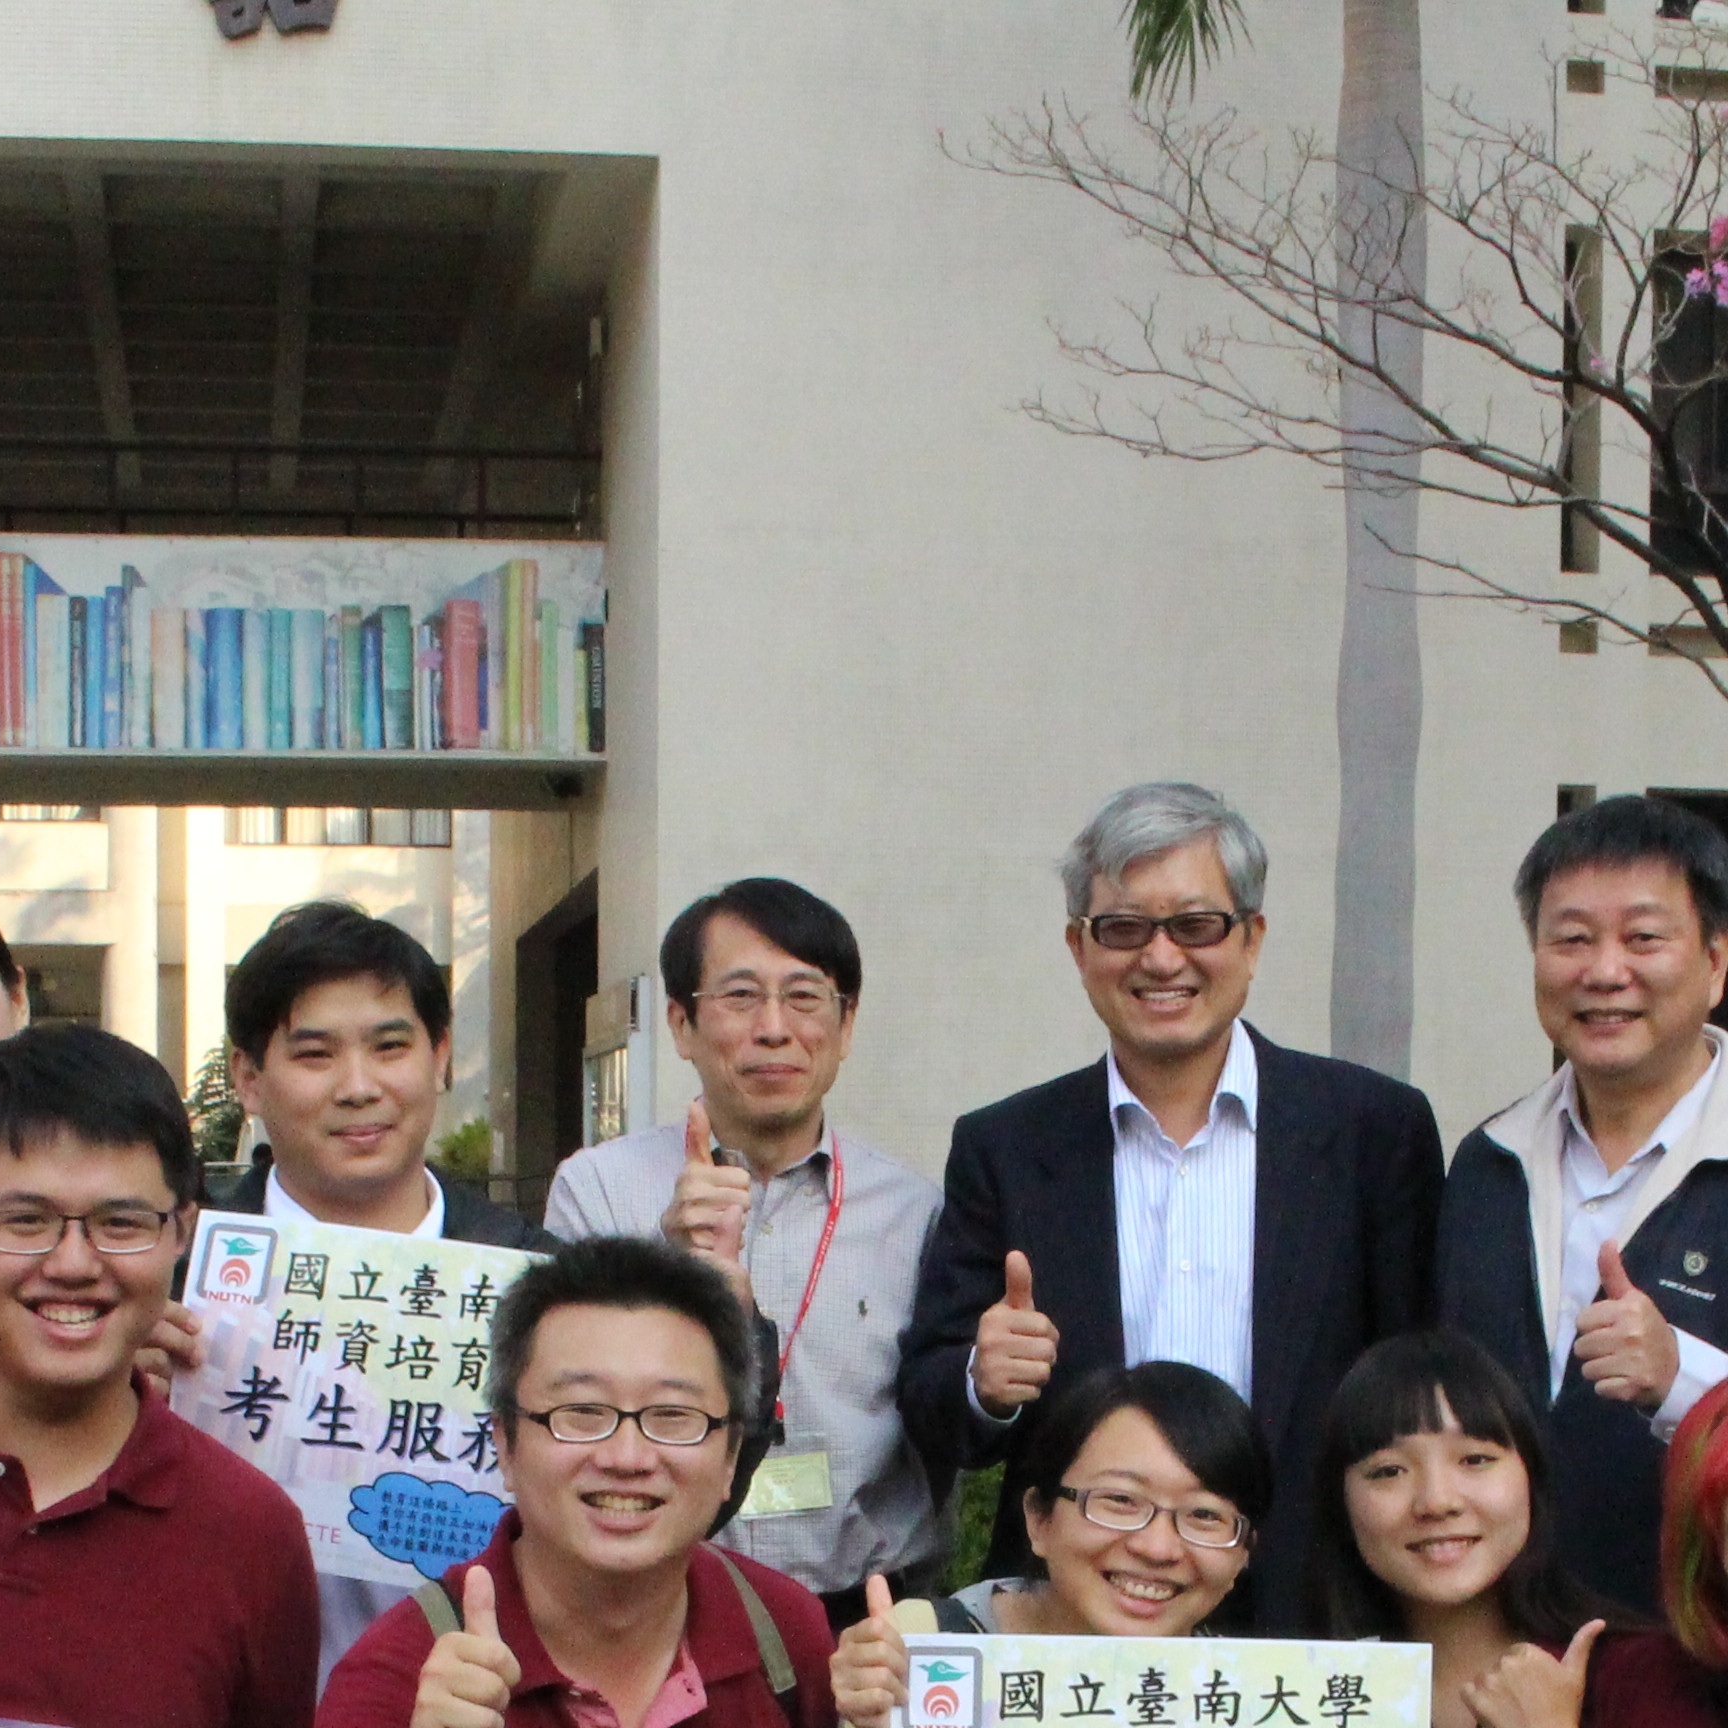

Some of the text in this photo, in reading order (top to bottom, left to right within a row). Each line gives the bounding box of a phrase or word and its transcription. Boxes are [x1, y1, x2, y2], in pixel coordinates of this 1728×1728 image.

[208, 1291, 252, 1304] NUTN
[273, 1309, 490, 1391] 師資培育
